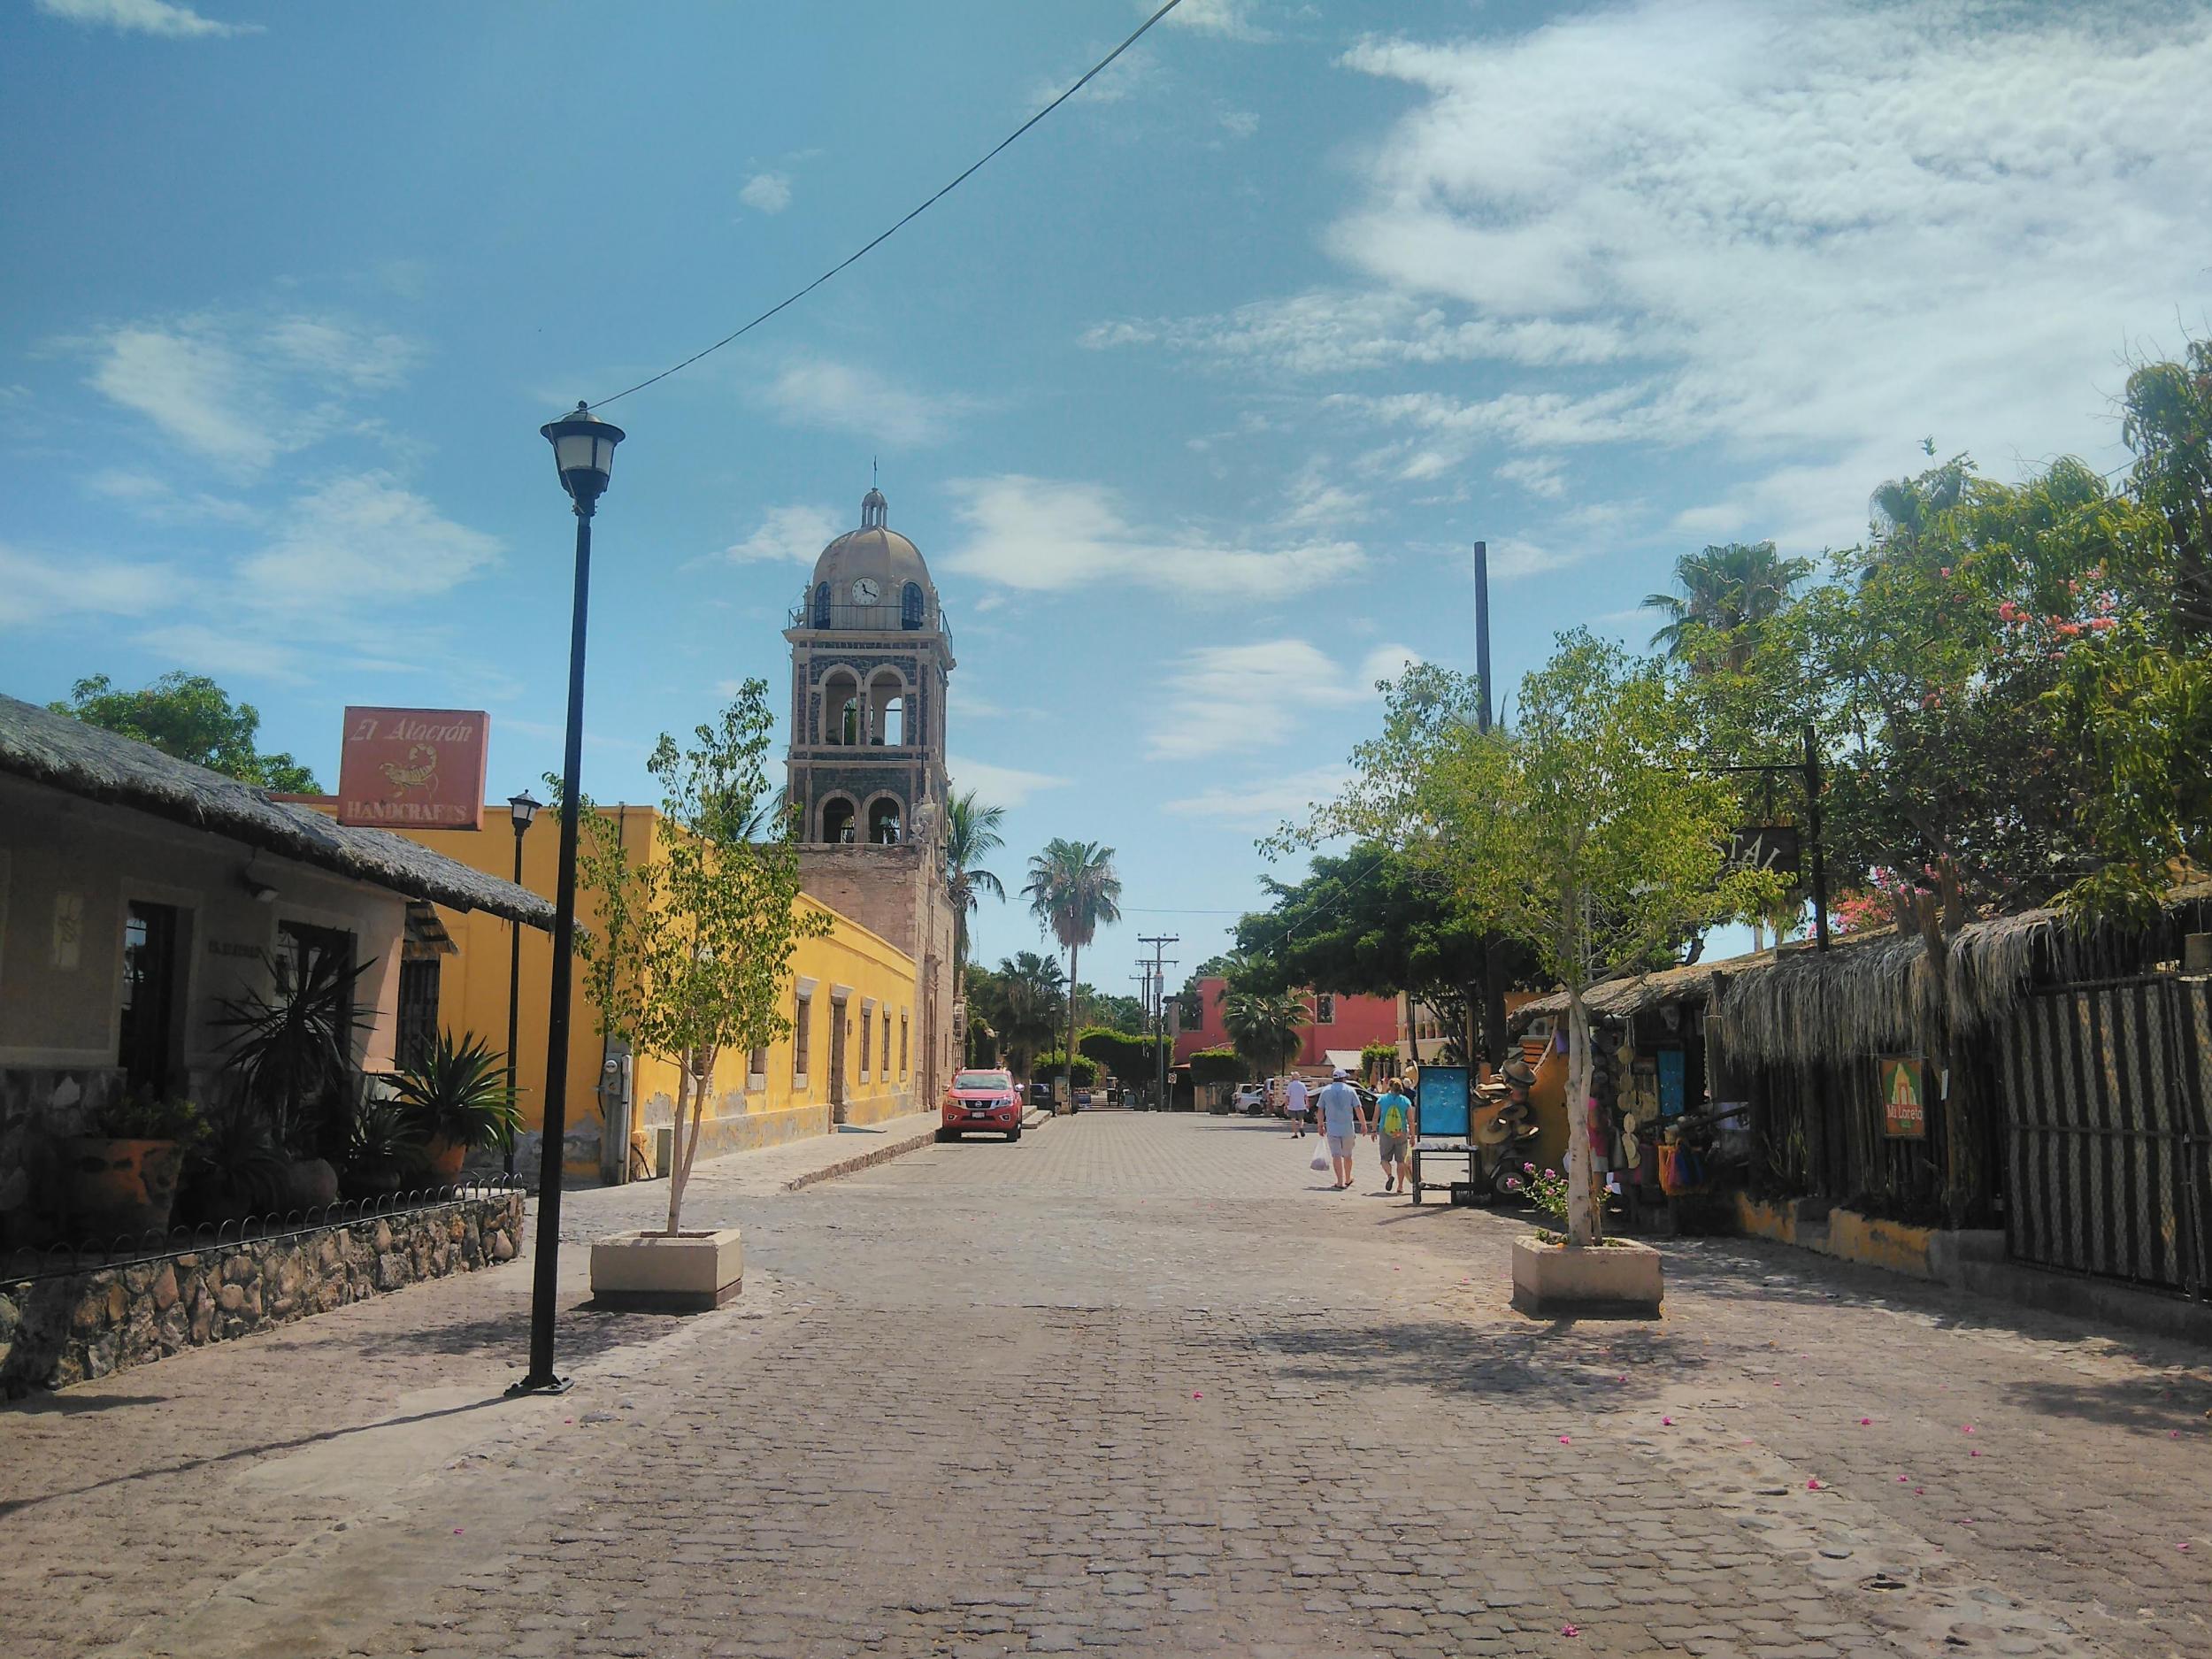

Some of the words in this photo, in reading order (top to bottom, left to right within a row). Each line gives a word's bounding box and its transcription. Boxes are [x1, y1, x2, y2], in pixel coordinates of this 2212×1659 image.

[350, 718, 379, 741] El
[383, 718, 472, 742] Alacrán
[1886, 1104, 1897, 1118] Mi
[1898, 1104, 1923, 1120] Loreto
